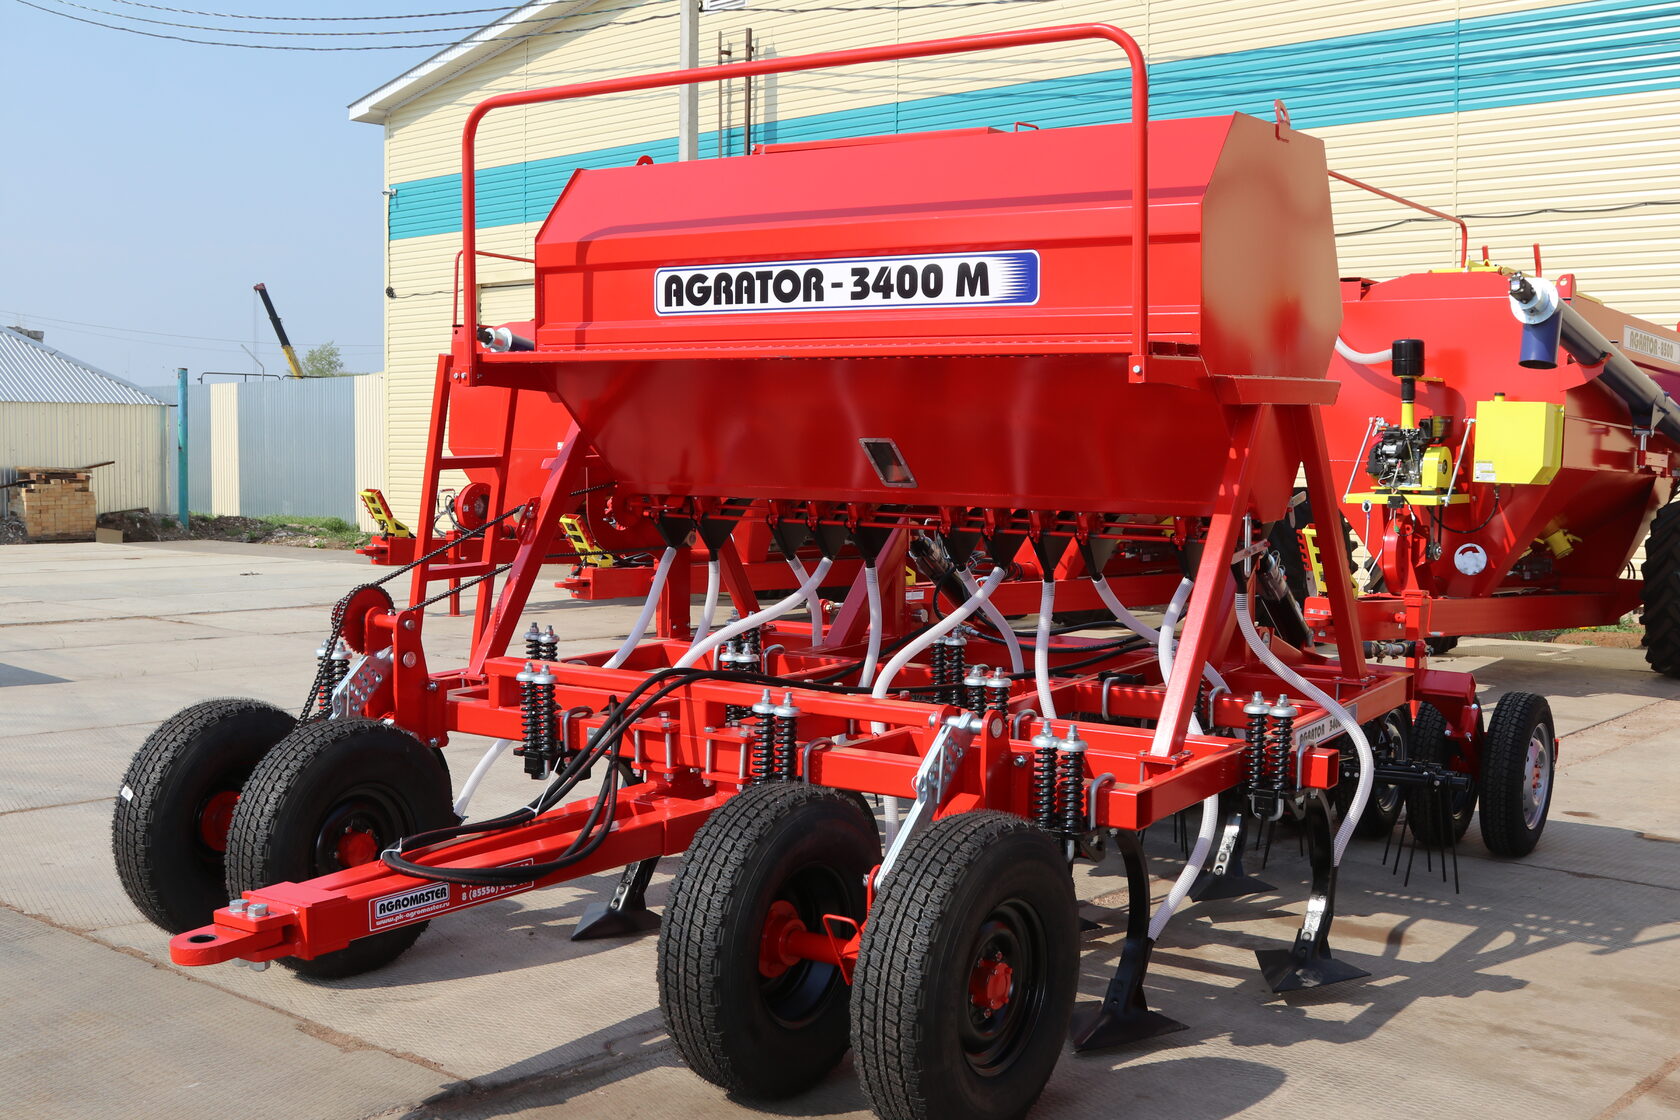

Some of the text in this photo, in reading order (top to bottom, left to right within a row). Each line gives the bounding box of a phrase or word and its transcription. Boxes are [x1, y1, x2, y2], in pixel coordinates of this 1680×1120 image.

[955, 261, 990, 297] M
[379, 887, 447, 915] AGROMASTER
[461, 892, 467, 901] 8
[375, 901, 450, 926] www.pk-agromaster.ru
